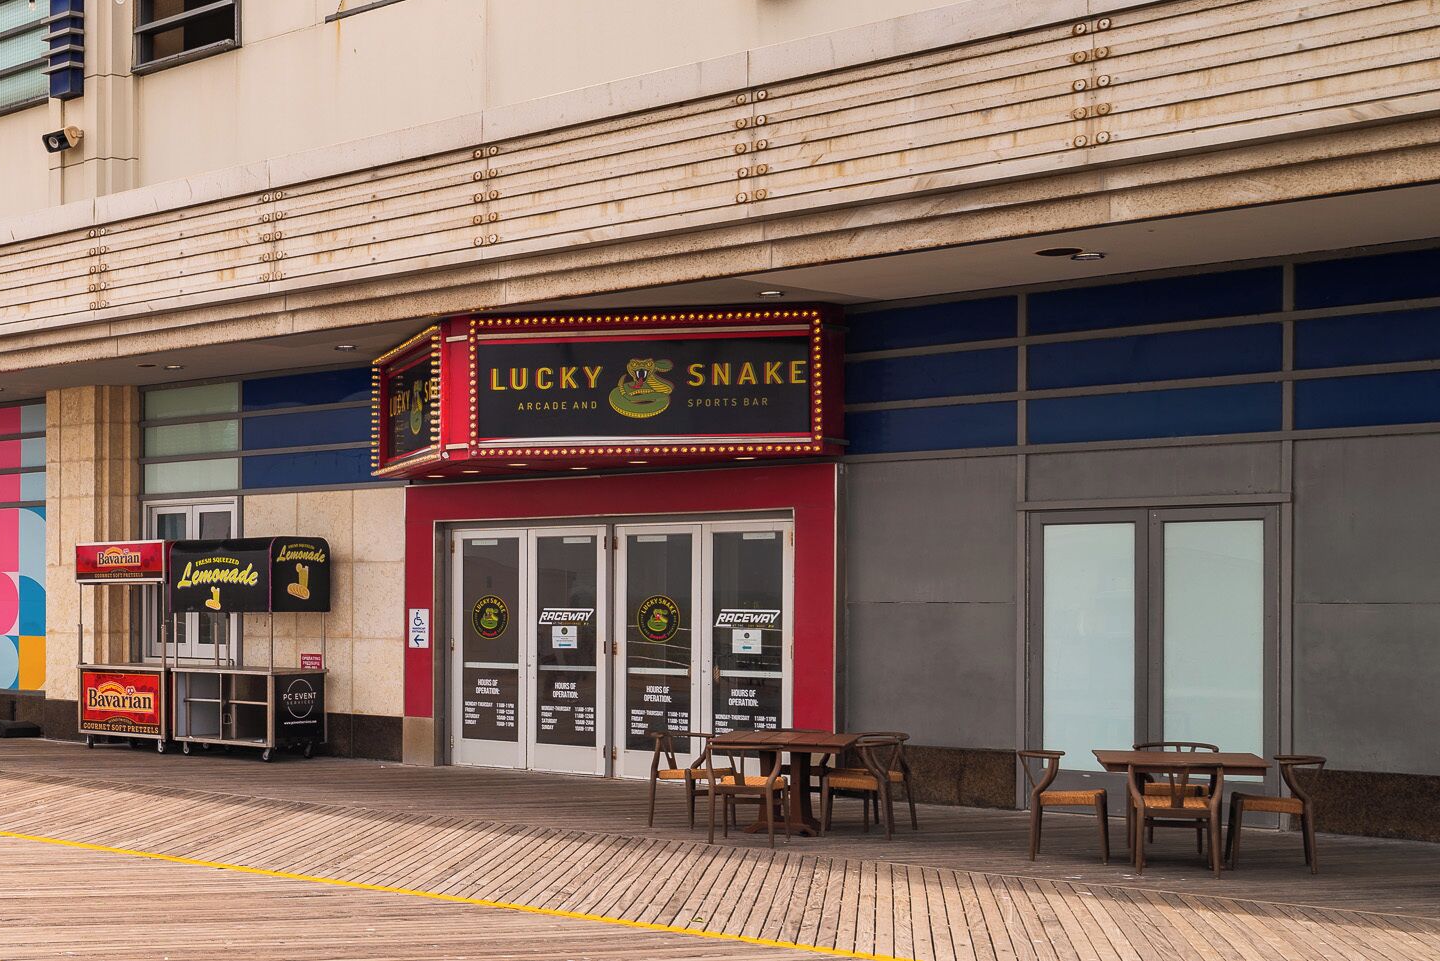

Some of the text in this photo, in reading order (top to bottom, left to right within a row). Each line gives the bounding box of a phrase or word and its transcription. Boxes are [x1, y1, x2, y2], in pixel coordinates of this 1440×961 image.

[490, 360, 807, 391] LUCKY SNAKE
[518, 397, 769, 410] ARCADE AND SPORTS BAR
[98, 551, 140, 565] Bavarian
[276, 544, 326, 563] Lemonade
[195, 556, 240, 567] FRESH SQUEEZED
[177, 561, 259, 589] Lemonade
[641, 597, 658, 614] LUCKY
[542, 611, 592, 621] RACEWAY
[719, 613, 776, 623] RACEWAY
[646, 685, 662, 693] HOURS
[748, 689, 756, 697] OF
[88, 686, 152, 710] Bavarian
[295, 692, 317, 700] EVENT
[83, 722, 111, 731] GOURMET
[111, 724, 127, 732] SOFT
[127, 725, 159, 734] PRETZELS
